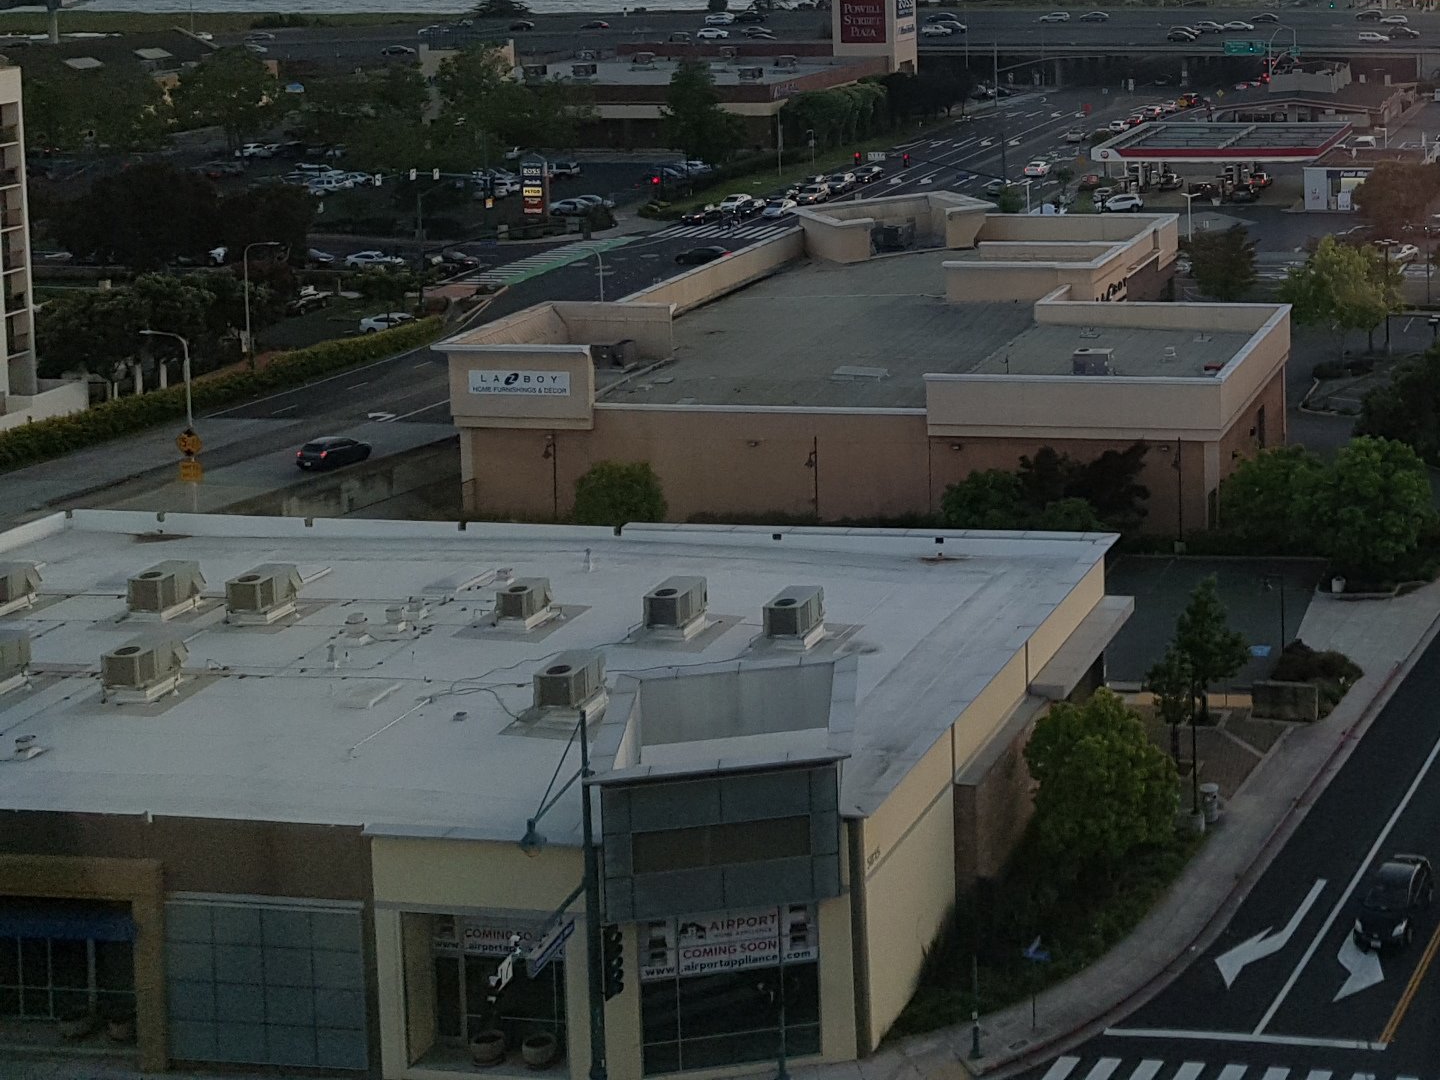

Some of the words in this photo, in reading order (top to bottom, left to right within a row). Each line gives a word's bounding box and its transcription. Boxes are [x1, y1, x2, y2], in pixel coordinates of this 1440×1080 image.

[843, 3, 880, 14] POWELL
[843, 16, 881, 25] STREET
[850, 27, 877, 37] PLAZA
[710, 914, 777, 932] AIRPORT
[683, 945, 737, 960] COMING
[740, 940, 777, 953] SOON
